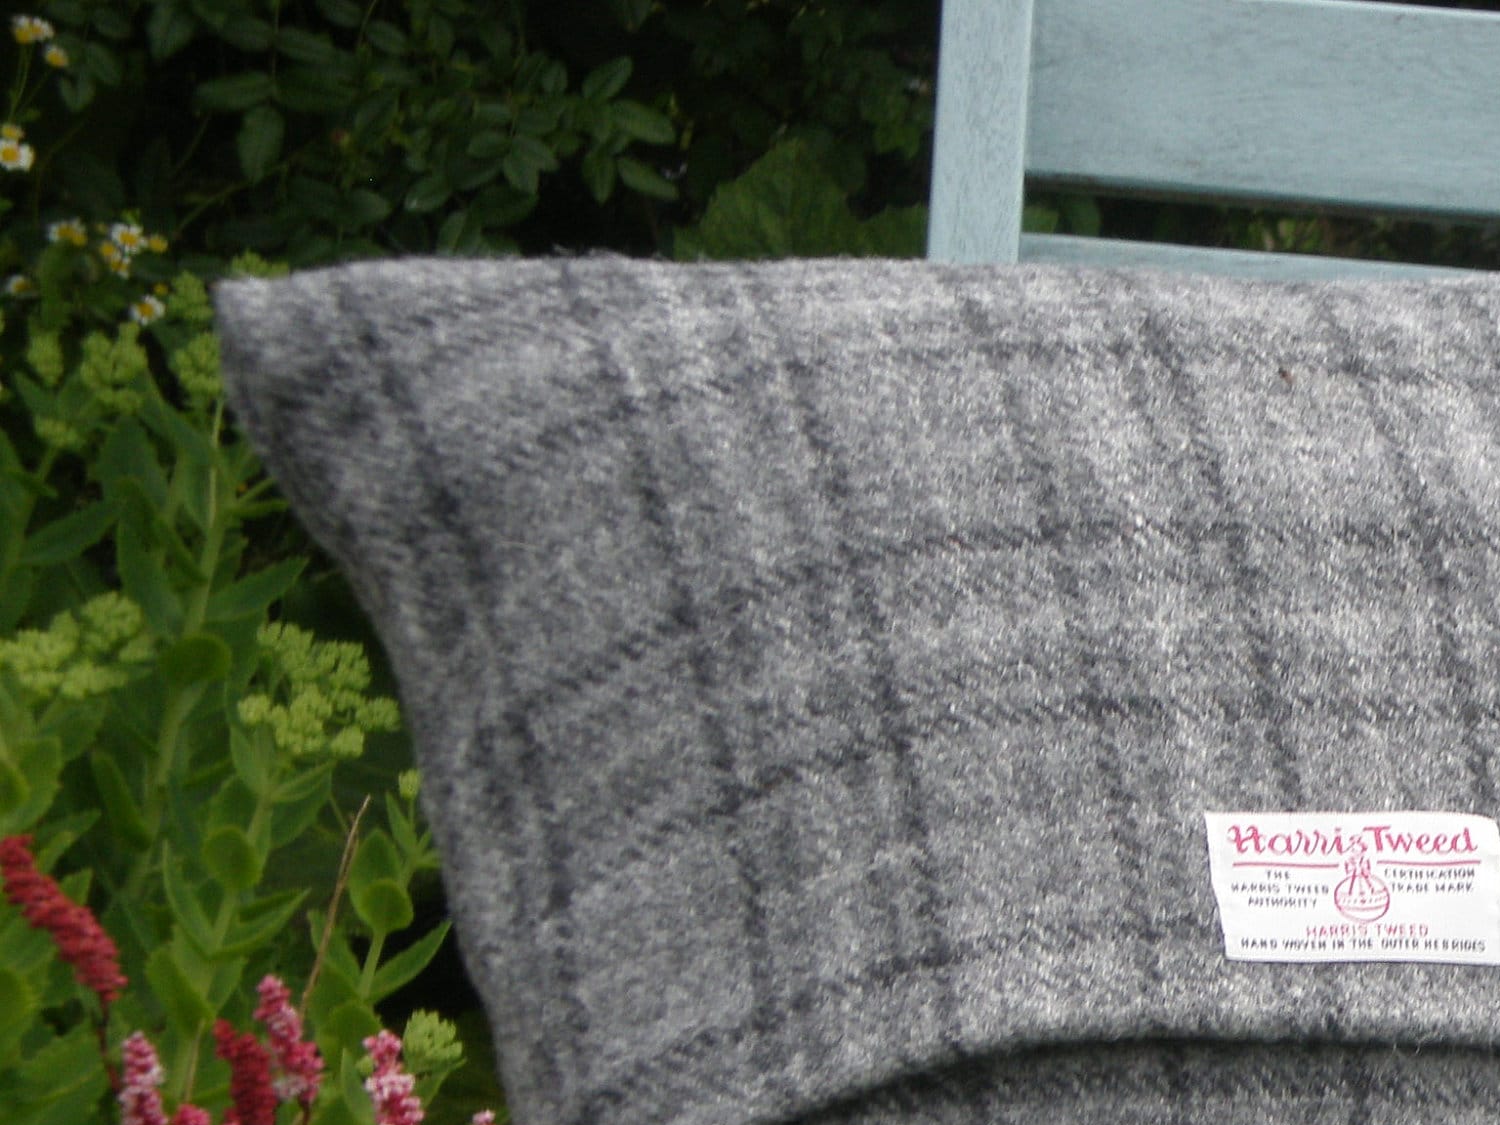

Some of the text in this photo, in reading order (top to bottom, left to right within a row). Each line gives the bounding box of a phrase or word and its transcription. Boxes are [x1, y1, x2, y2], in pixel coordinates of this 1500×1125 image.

[1227, 824, 1478, 855] Harris Tweed
[1266, 869, 1290, 880] THE
[1384, 867, 1475, 880] CERTIFICATION
[1391, 882, 1474, 894] TRADE MARK
[1306, 924, 1429, 938] HARRIS TWEED
[1241, 938, 1486, 951] HAND WOVEN IN THE OUTER HEBRIDES
